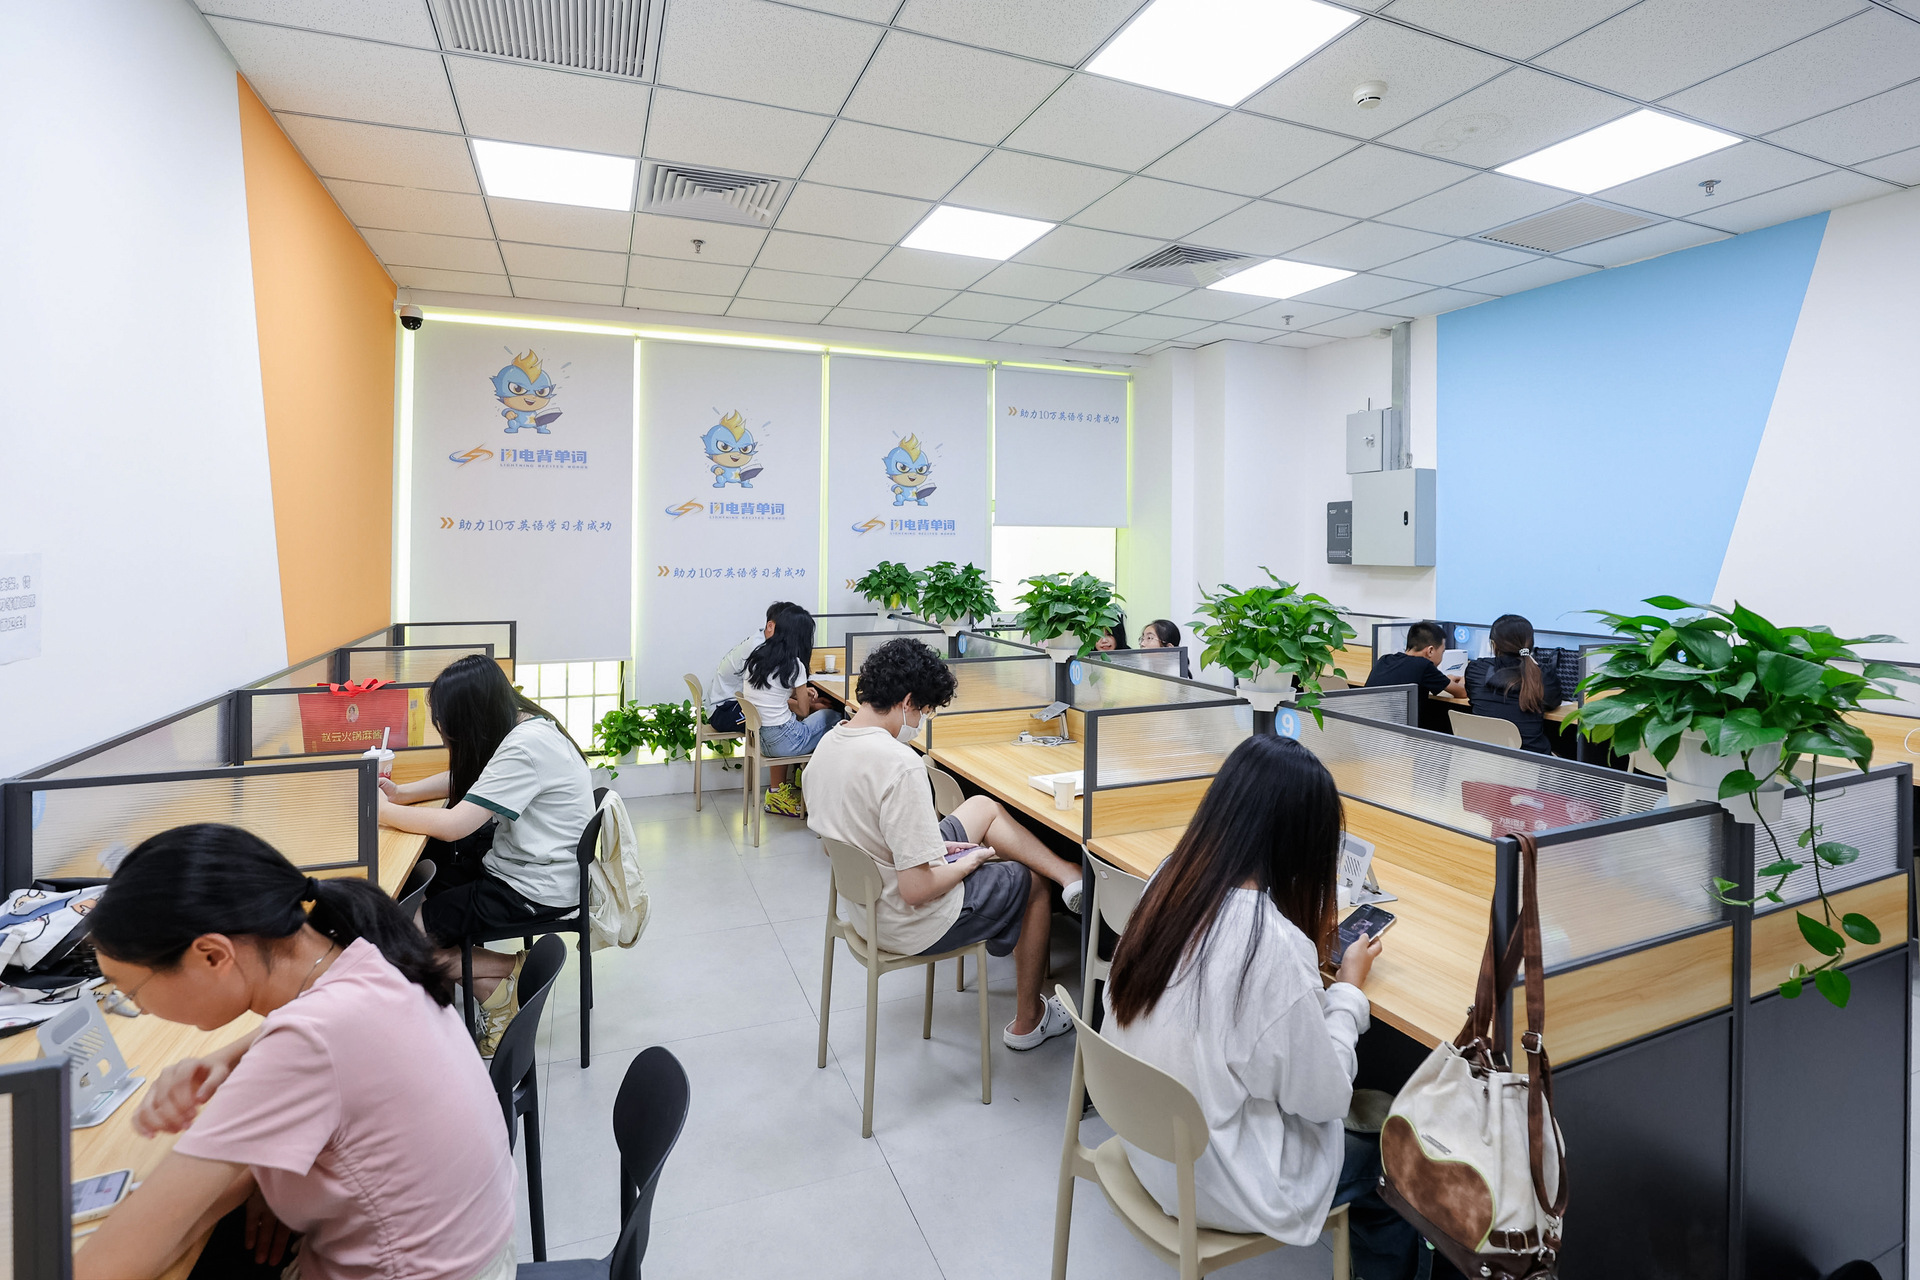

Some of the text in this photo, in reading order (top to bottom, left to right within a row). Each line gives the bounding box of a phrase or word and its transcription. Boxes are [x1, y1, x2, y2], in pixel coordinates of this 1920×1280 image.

[1020, 408, 1120, 424] 助力10万英语学习者成功
[500, 448, 587, 464] 闪电背单词
[710, 502, 785, 515] 闪电背单词
[458, 518, 612, 532] 助力10万英语学习者成功
[890, 519, 955, 531] 闪电背单词
[673, 566, 806, 579] 助力10万英语学习者成功
[1458, 628, 1466, 640] 3
[1072, 664, 1080, 681] 10
[1281, 713, 1295, 737] 9
